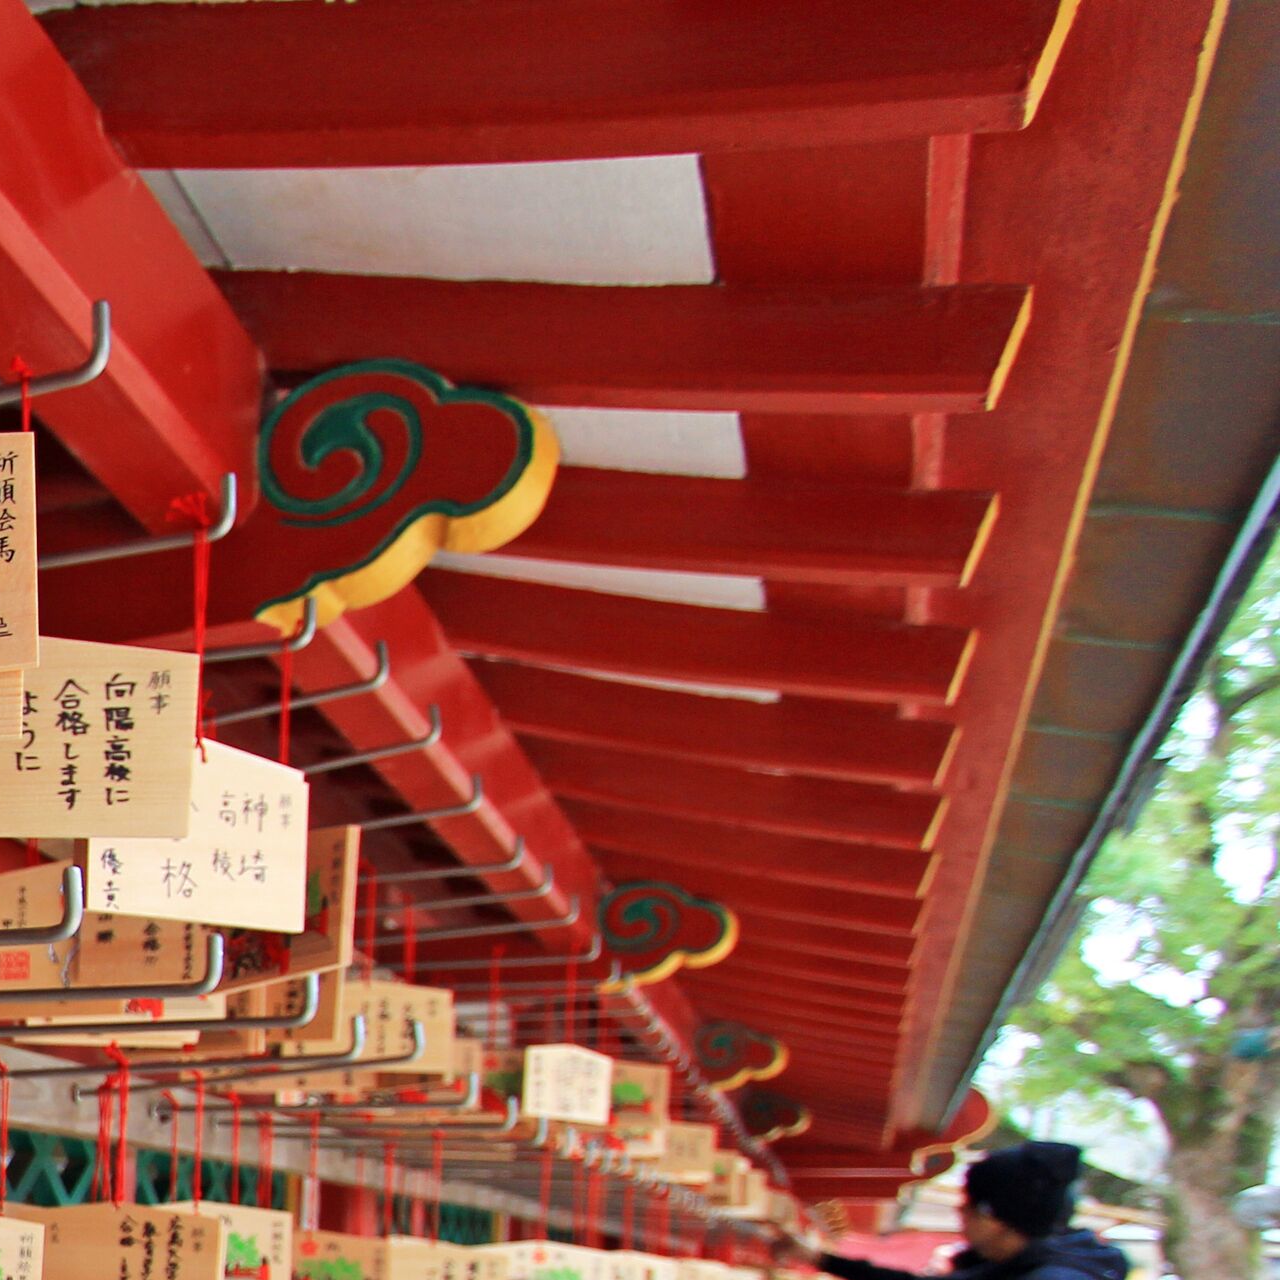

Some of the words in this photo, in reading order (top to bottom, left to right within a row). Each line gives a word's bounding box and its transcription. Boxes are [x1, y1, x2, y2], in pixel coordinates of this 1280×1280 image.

[54, 678, 91, 810] 合格します
[103, 674, 138, 806] 向陽高校に
[146, 669, 172, 716] 願事
